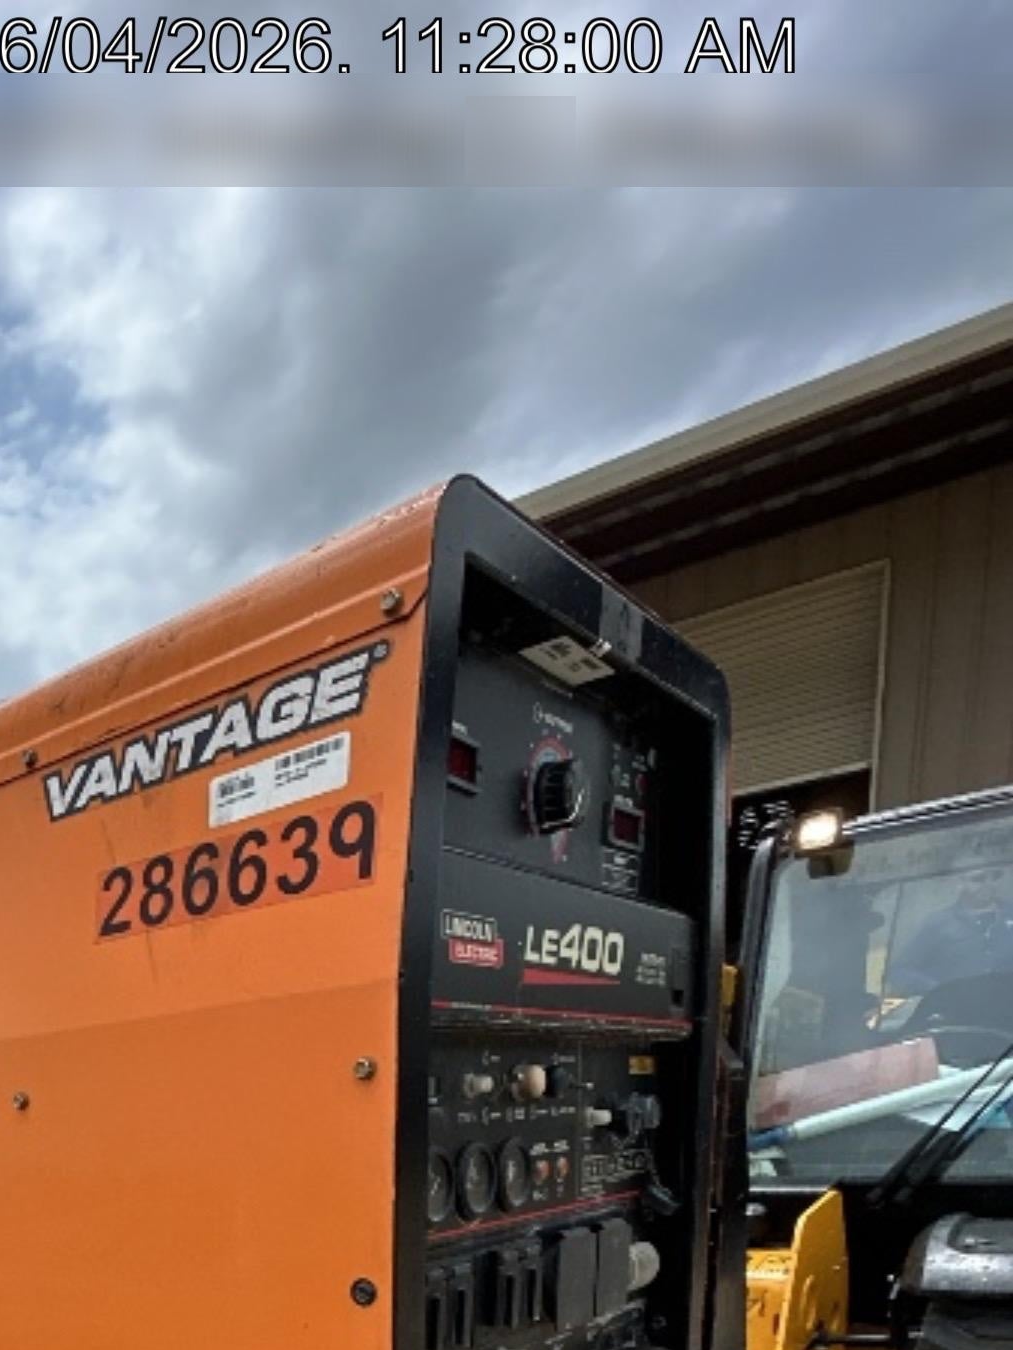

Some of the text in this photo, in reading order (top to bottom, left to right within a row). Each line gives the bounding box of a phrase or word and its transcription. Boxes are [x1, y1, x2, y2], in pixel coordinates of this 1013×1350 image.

[44, 651, 371, 818] VANTAGE
[98, 800, 376, 937] 286639
[523, 922, 624, 976] LE400
